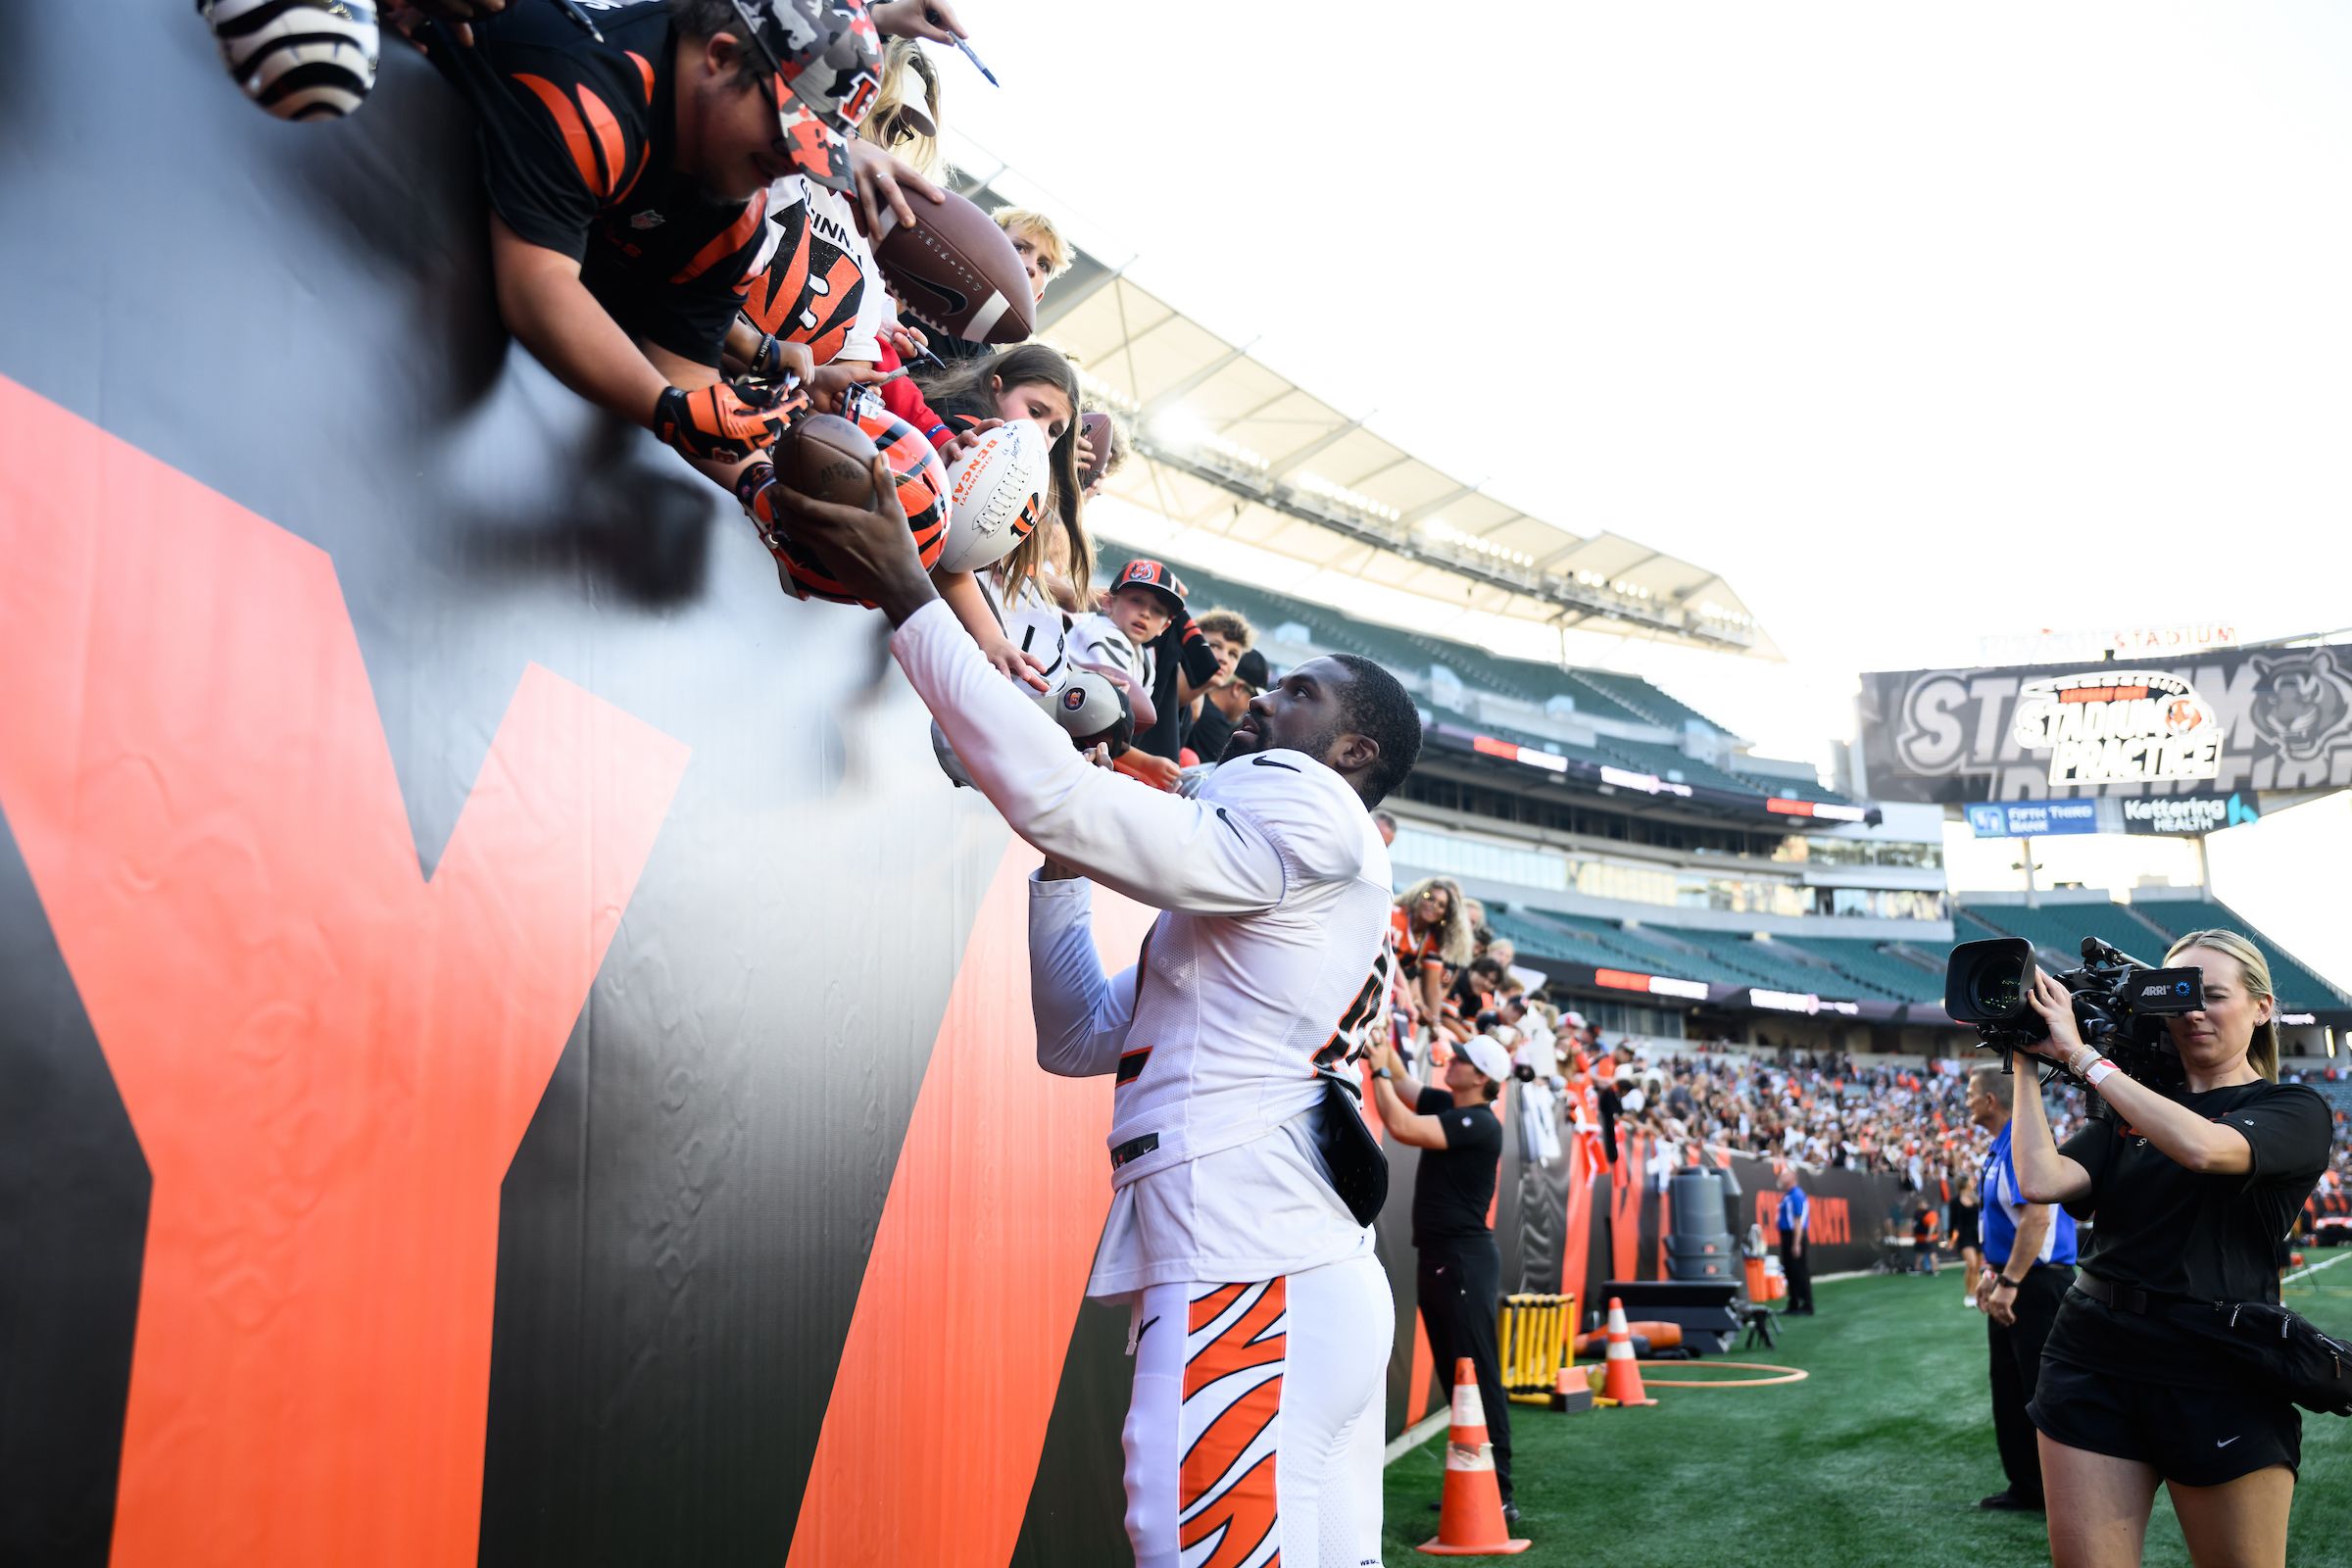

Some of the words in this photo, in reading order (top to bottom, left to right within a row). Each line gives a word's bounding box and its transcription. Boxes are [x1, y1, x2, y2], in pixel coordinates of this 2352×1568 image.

[959, 456, 993, 508] CINCINNATI
[2114, 625, 2235, 648] STADIUM
[2056, 739, 2218, 781] PRACTICE
[2008, 807, 2047, 821] FIFTH
[2048, 805, 2093, 819] THIRD
[2124, 797, 2226, 820] Kettering
[2153, 814, 2214, 832] HEALTH
[2141, 985, 2166, 996] ARRI
